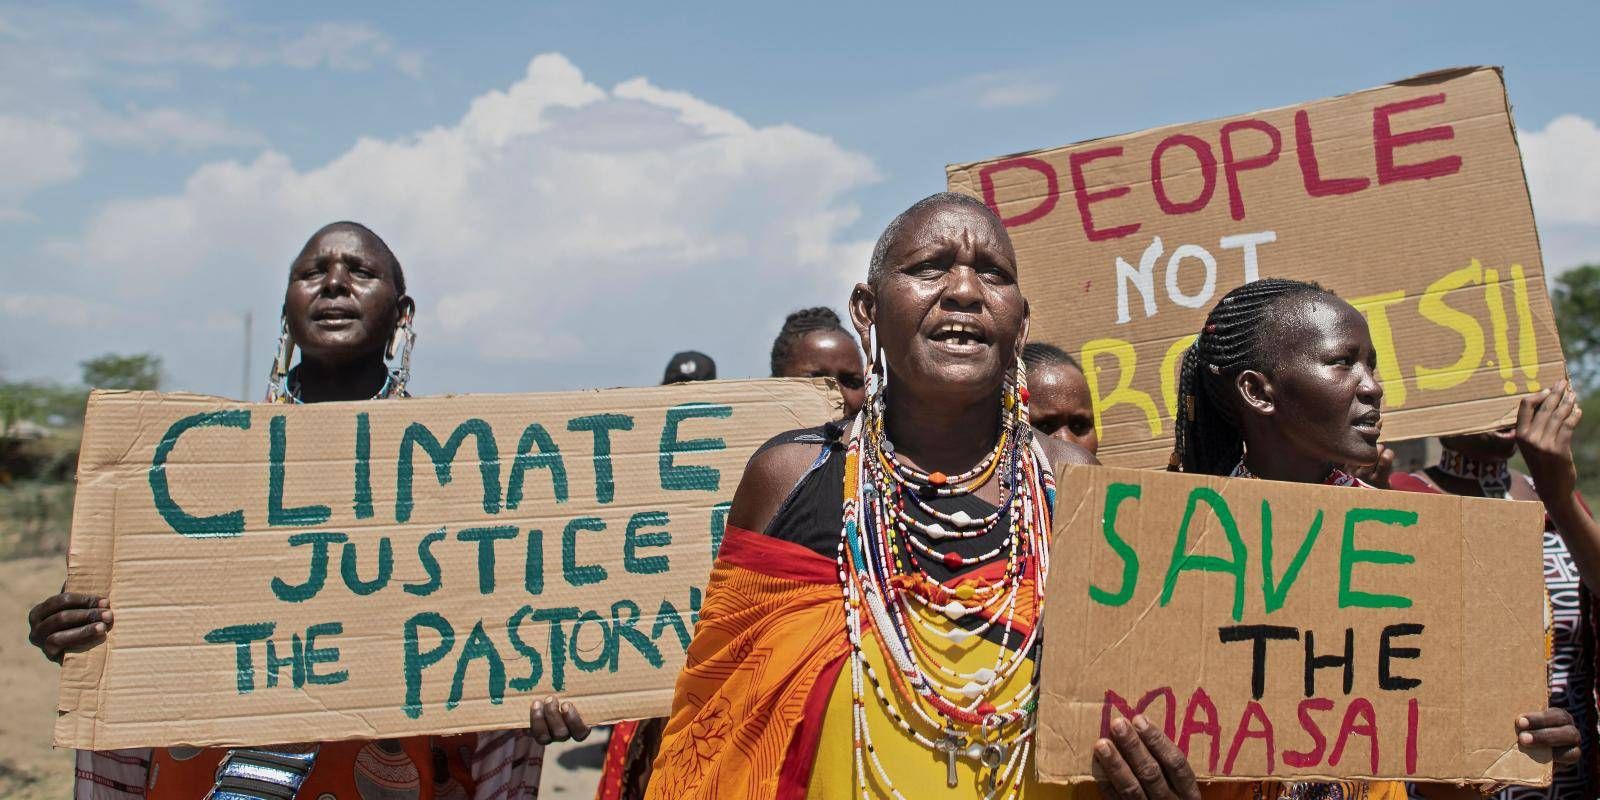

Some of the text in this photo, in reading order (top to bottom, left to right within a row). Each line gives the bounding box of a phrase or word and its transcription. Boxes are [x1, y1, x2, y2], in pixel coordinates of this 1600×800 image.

[978, 93, 1463, 242] PEOPLE
[1114, 230, 1277, 324] NOT
[148, 402, 733, 539] CLIMATE
[270, 511, 672, 603] JUSTICE
[1088, 482, 1419, 622] SAVE
[203, 621, 350, 695] THE
[1218, 623, 1426, 700] THE
[1099, 686, 1420, 776] MAASAI
